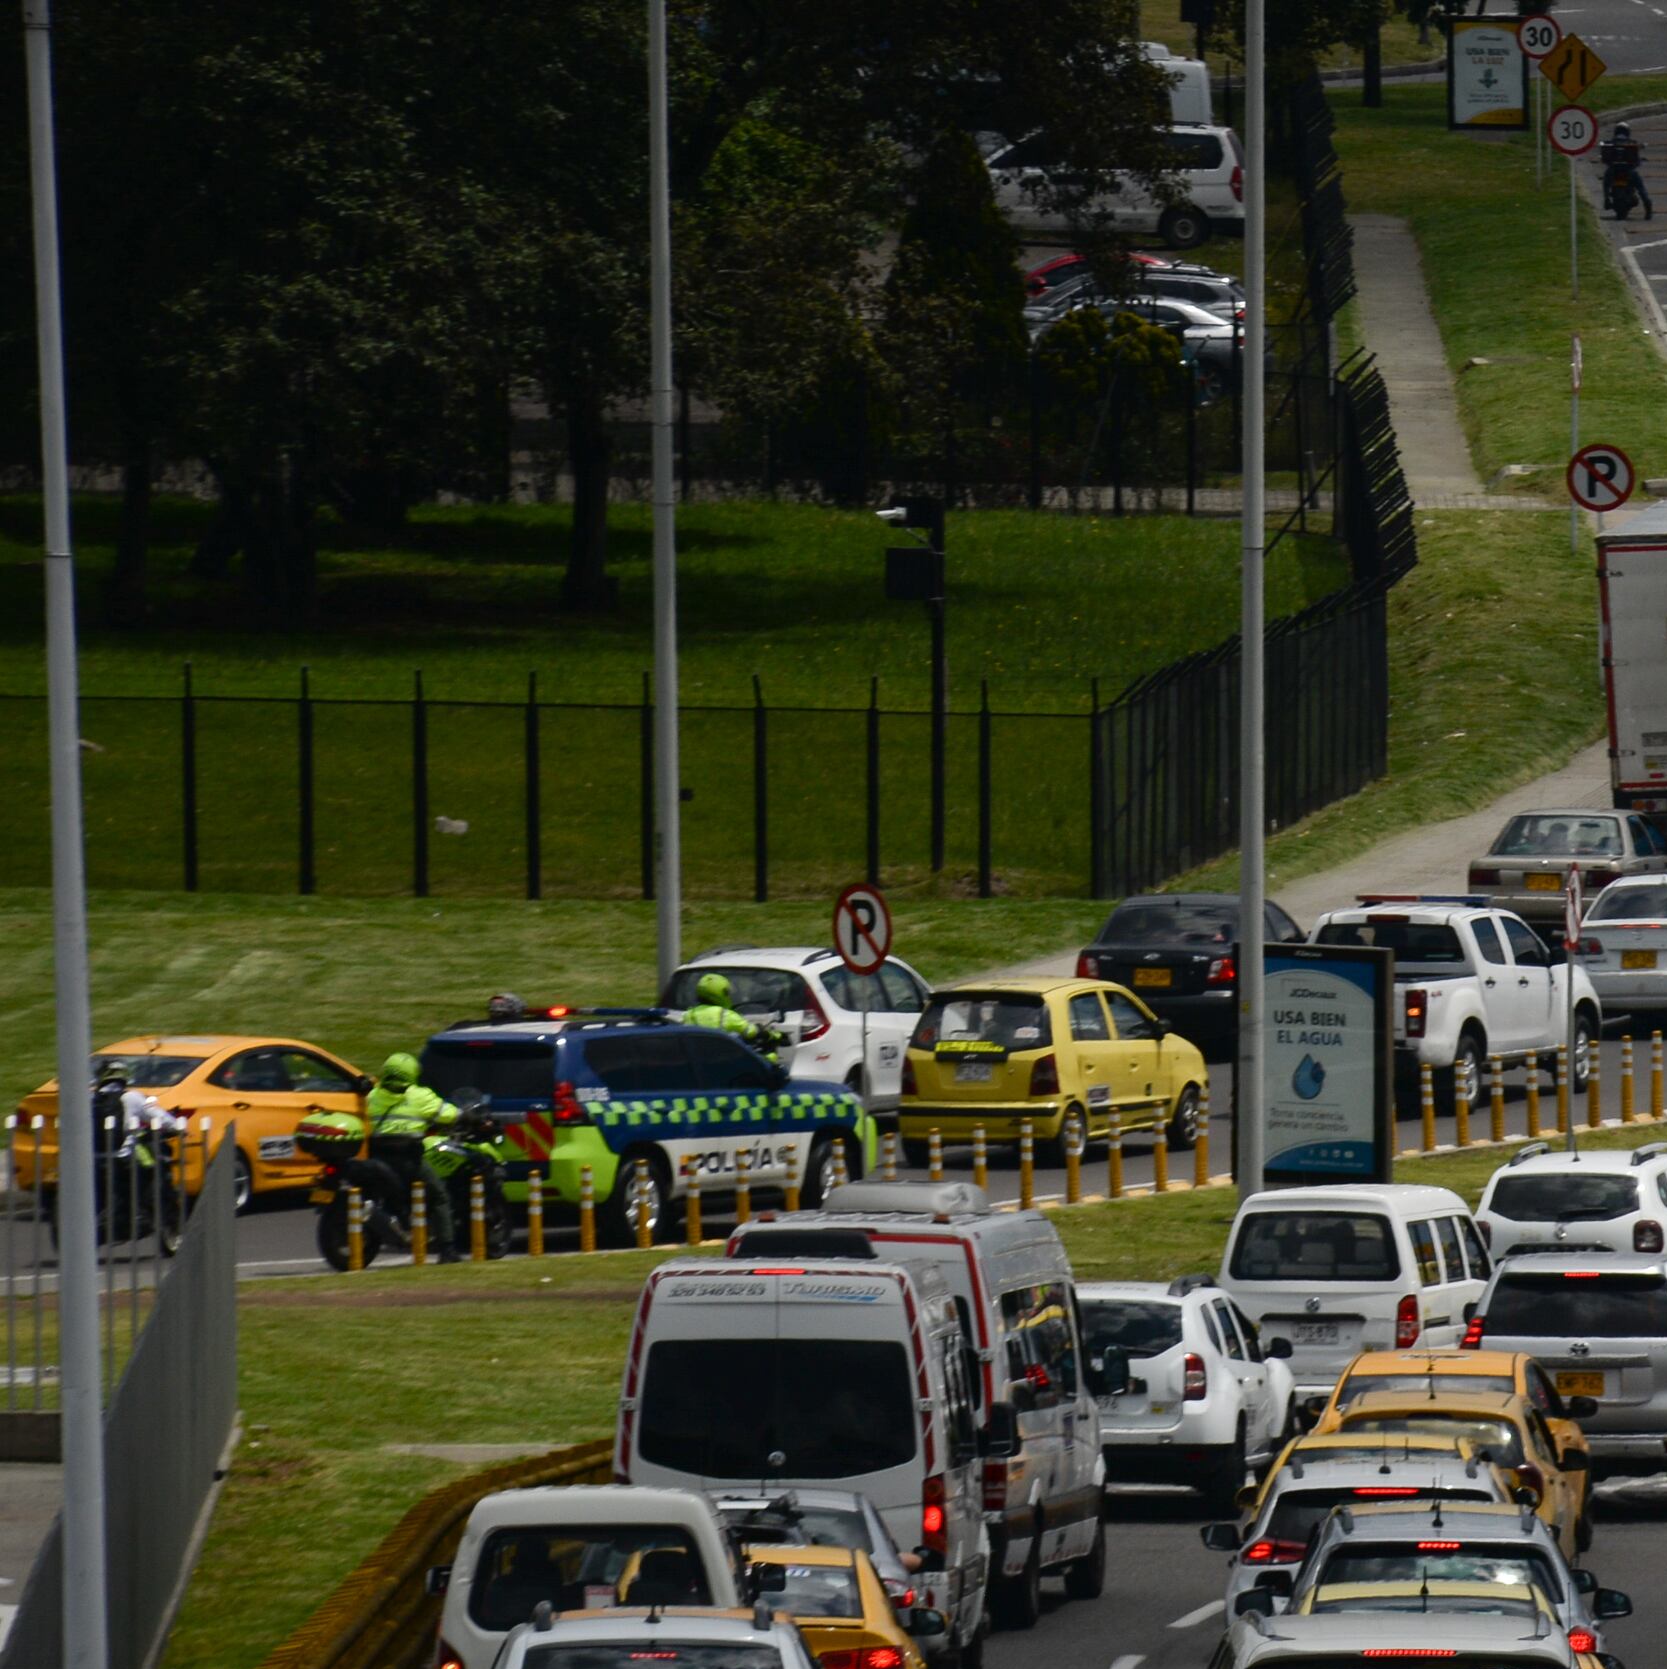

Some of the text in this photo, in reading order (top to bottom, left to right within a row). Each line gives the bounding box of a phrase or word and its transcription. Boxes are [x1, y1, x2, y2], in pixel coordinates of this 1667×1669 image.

[1526, 26, 1553, 47] 30
[1560, 120, 1585, 139] 30
[1274, 1010, 1346, 1027] USA BIEN
[1276, 1030, 1344, 1047] EL AGUA
